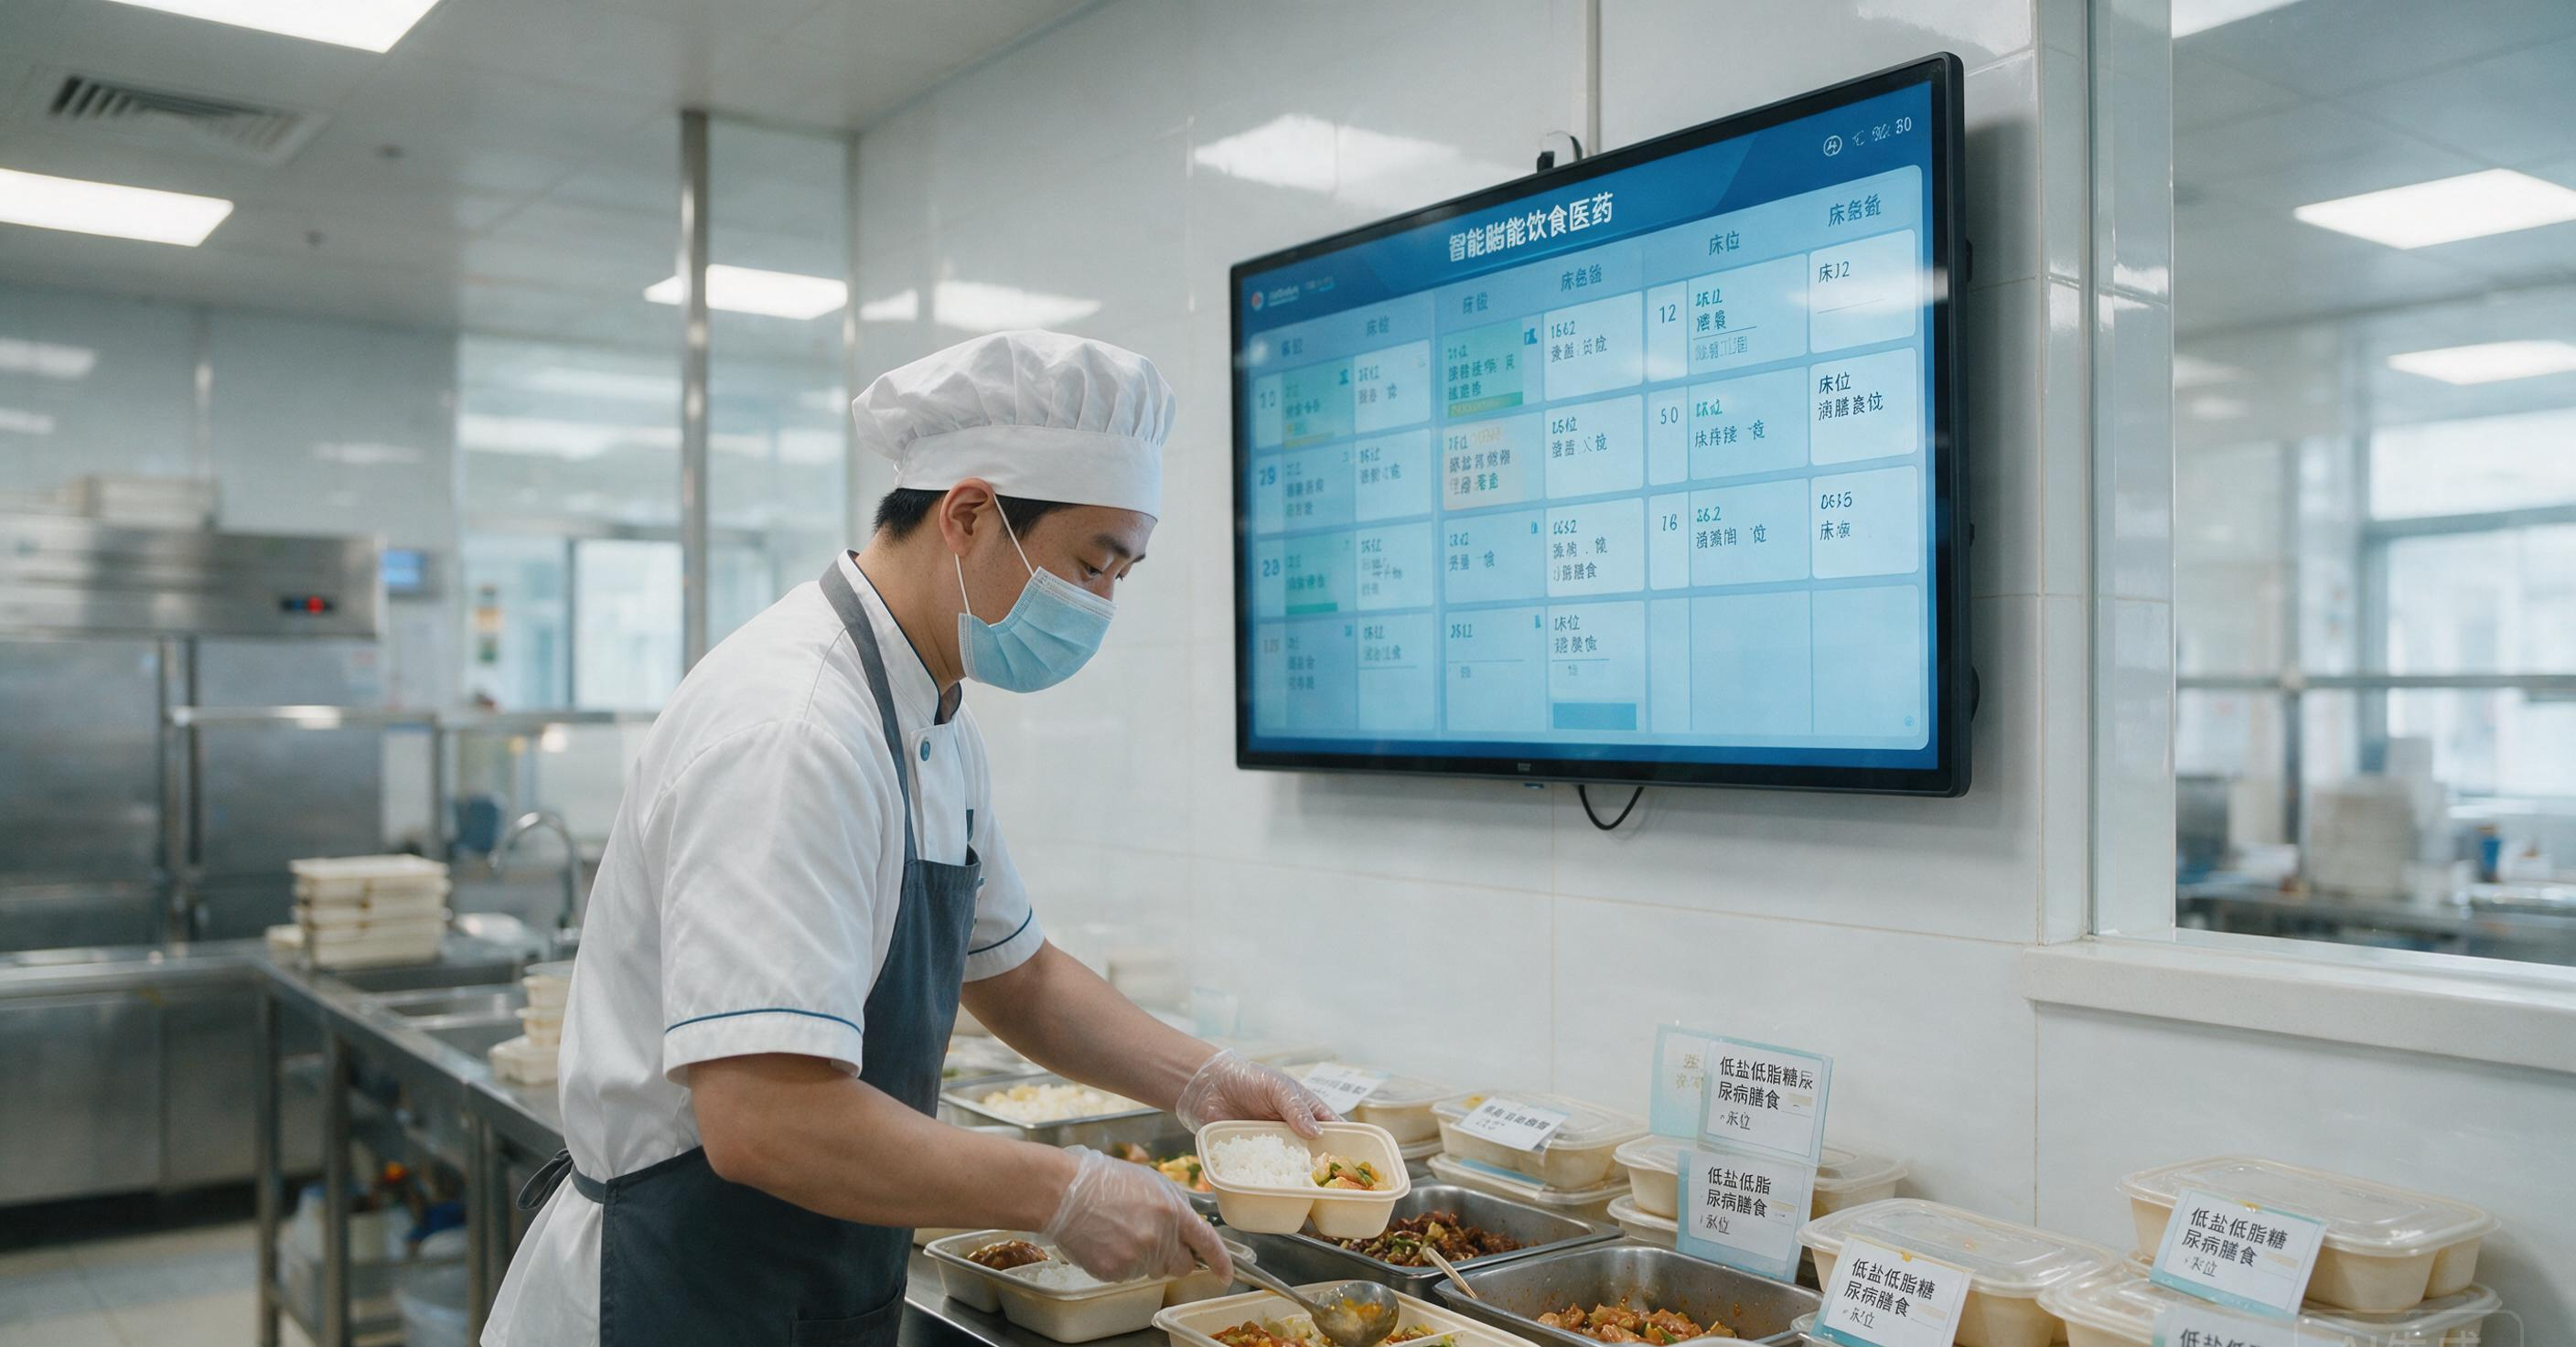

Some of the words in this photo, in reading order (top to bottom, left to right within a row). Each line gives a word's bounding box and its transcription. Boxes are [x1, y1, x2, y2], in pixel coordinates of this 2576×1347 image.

[1709, 230, 1740, 256] 床位
[1659, 305, 1677, 324] 12
[1819, 371, 1851, 394] 床位
[1661, 407, 1679, 424] 50
[1720, 1056, 1813, 1090] 低盐低脂糖尿
[1718, 1081, 1780, 1110] 尿病膳食
[1708, 1166, 1771, 1195] 低盐低脂
[1706, 1189, 1767, 1218] 尿病膳食
[2191, 1207, 2288, 1249] 低盐低脂糖
[2182, 1229, 2258, 1267] 尿病膳食
[1852, 1258, 1936, 1300] 低盐低脂糖
[1844, 1280, 1910, 1317] 尿病膳食
